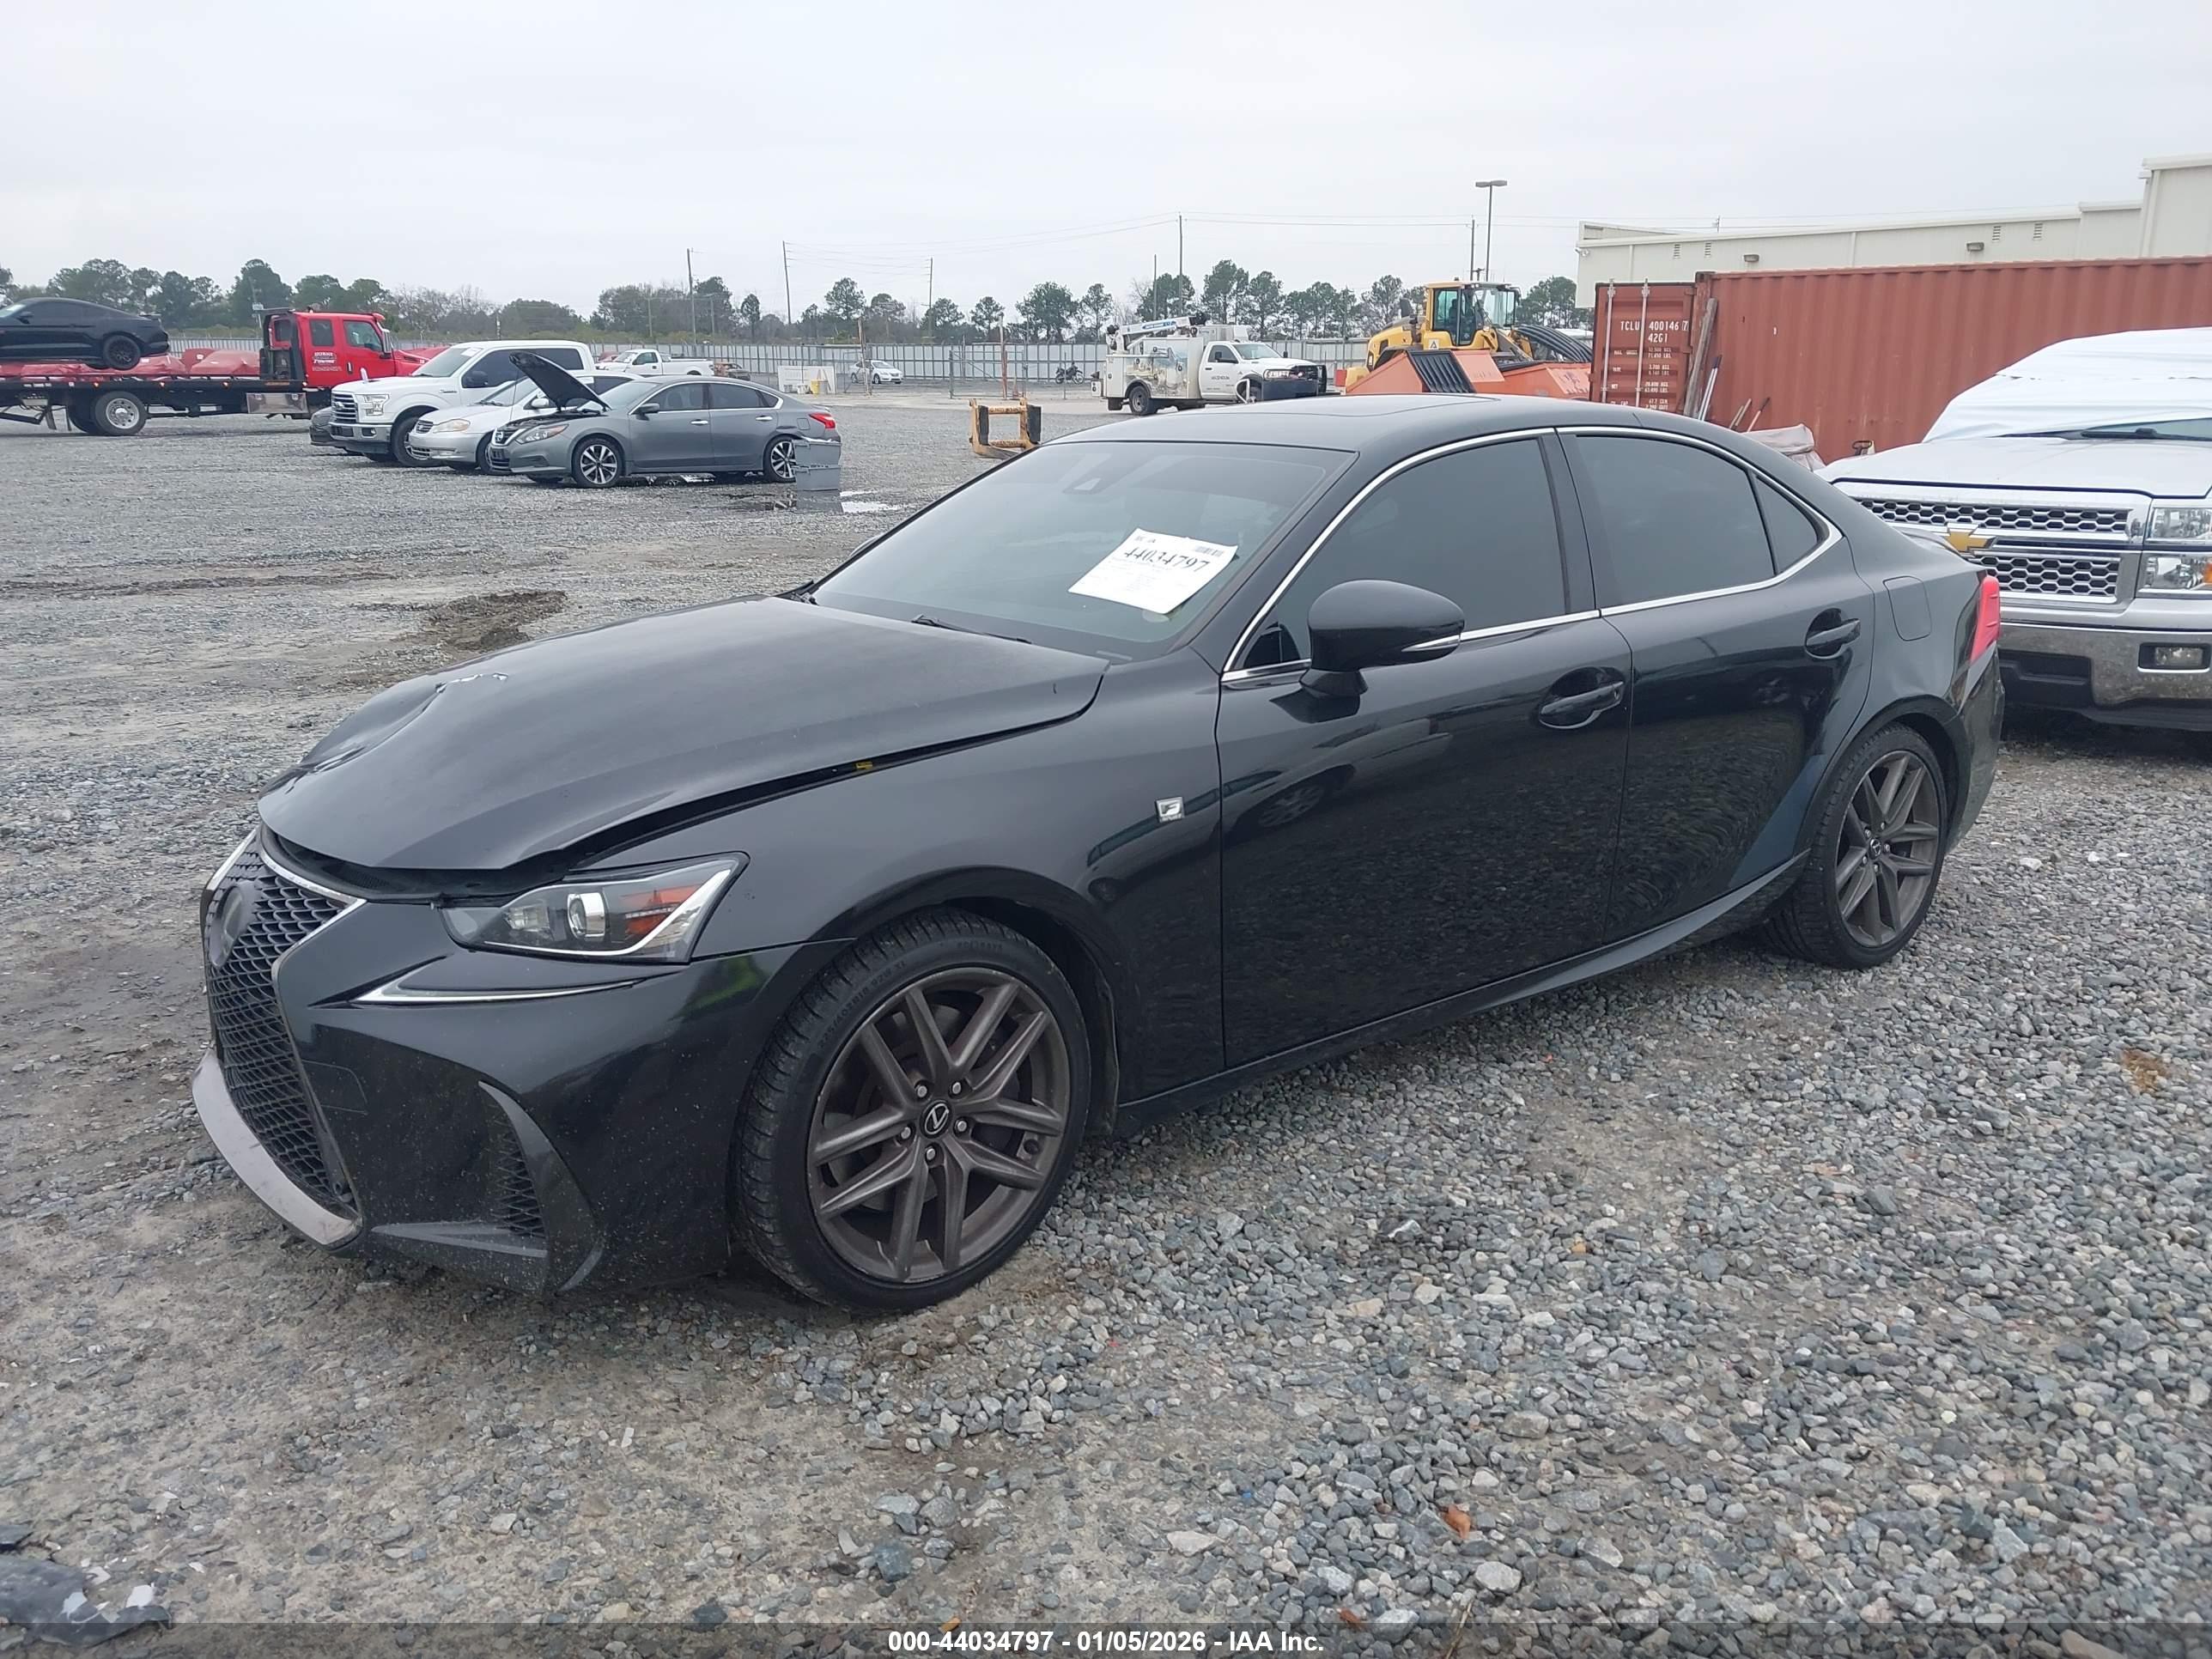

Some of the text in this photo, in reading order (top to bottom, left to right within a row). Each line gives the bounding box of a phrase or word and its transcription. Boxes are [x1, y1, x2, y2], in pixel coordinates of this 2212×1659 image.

[1620, 321, 1640, 331] TCLU
[1649, 320, 1680, 331] 400146
[1648, 332, 1668, 343] 42G1
[1124, 547, 1211, 573] 44034797
